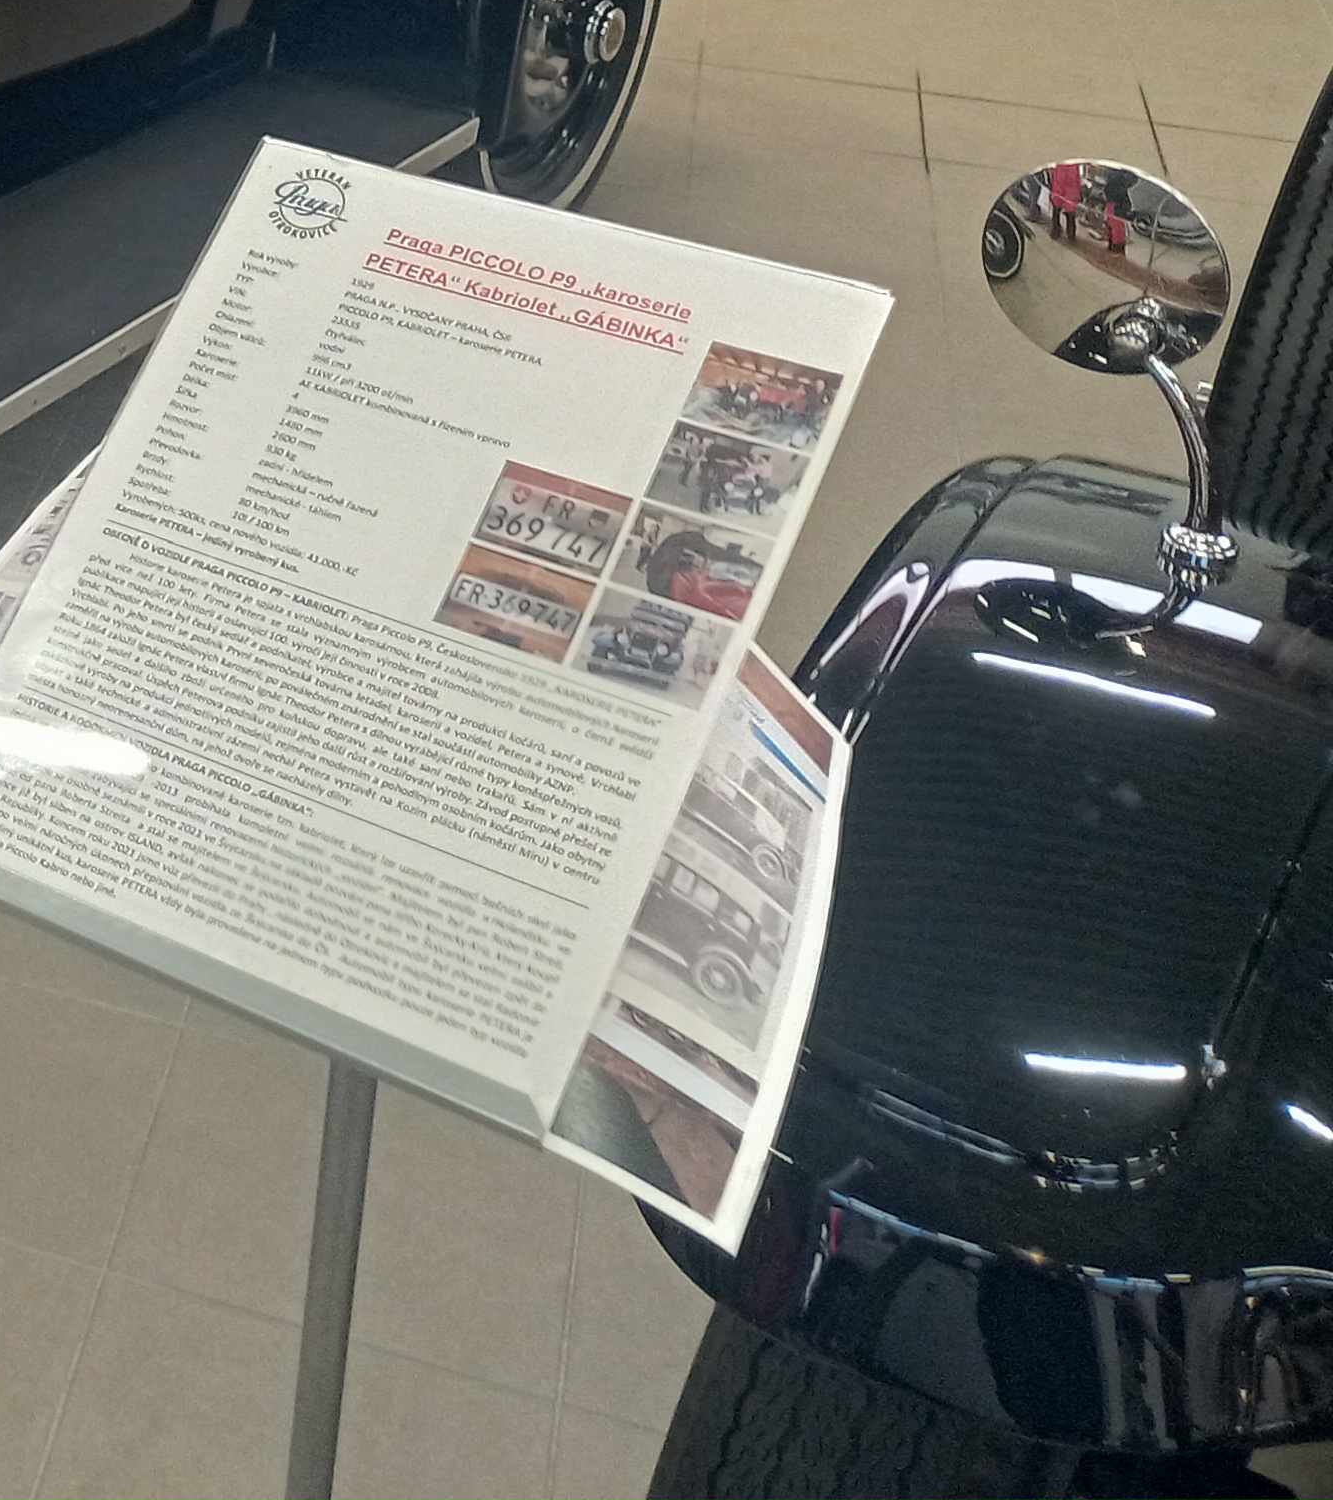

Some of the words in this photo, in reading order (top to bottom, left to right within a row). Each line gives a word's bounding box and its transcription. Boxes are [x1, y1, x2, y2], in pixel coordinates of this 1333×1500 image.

[385, 228, 443, 256] Praga
[448, 244, 544, 280] PICCOLO
[548, 270, 577, 288] P9
[463, 279, 556, 315] Kabriolet
[483, 504, 547, 545] 369
[550, 525, 610, 564] 747
